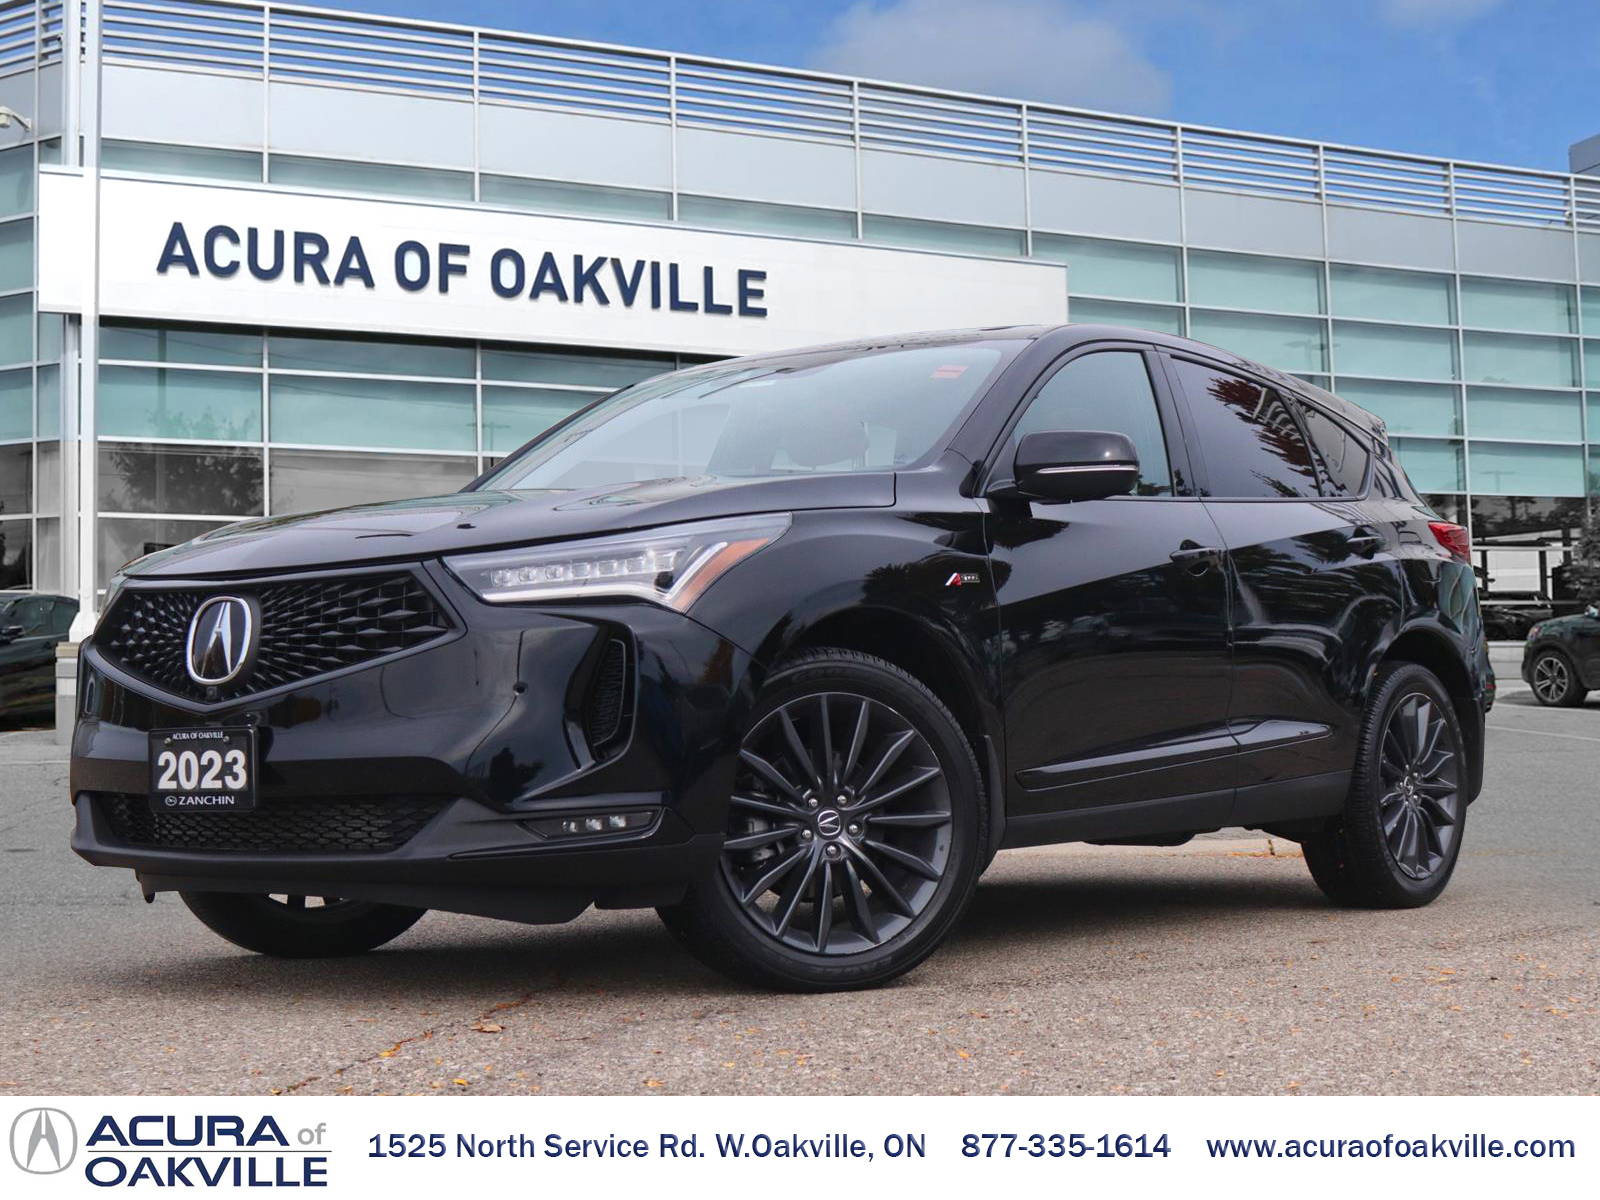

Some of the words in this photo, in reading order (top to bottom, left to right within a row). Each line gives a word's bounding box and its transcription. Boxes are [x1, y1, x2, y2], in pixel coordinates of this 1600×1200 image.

[156, 221, 375, 289] ACURA
[394, 240, 470, 294] OF
[490, 248, 768, 318] OAKVILLE
[172, 732, 190, 740] ACURA
[190, 732, 198, 740] OF
[198, 731, 224, 739] OAKVILLE
[157, 749, 248, 790] 2023
[178, 795, 235, 806] ZANCHIN
